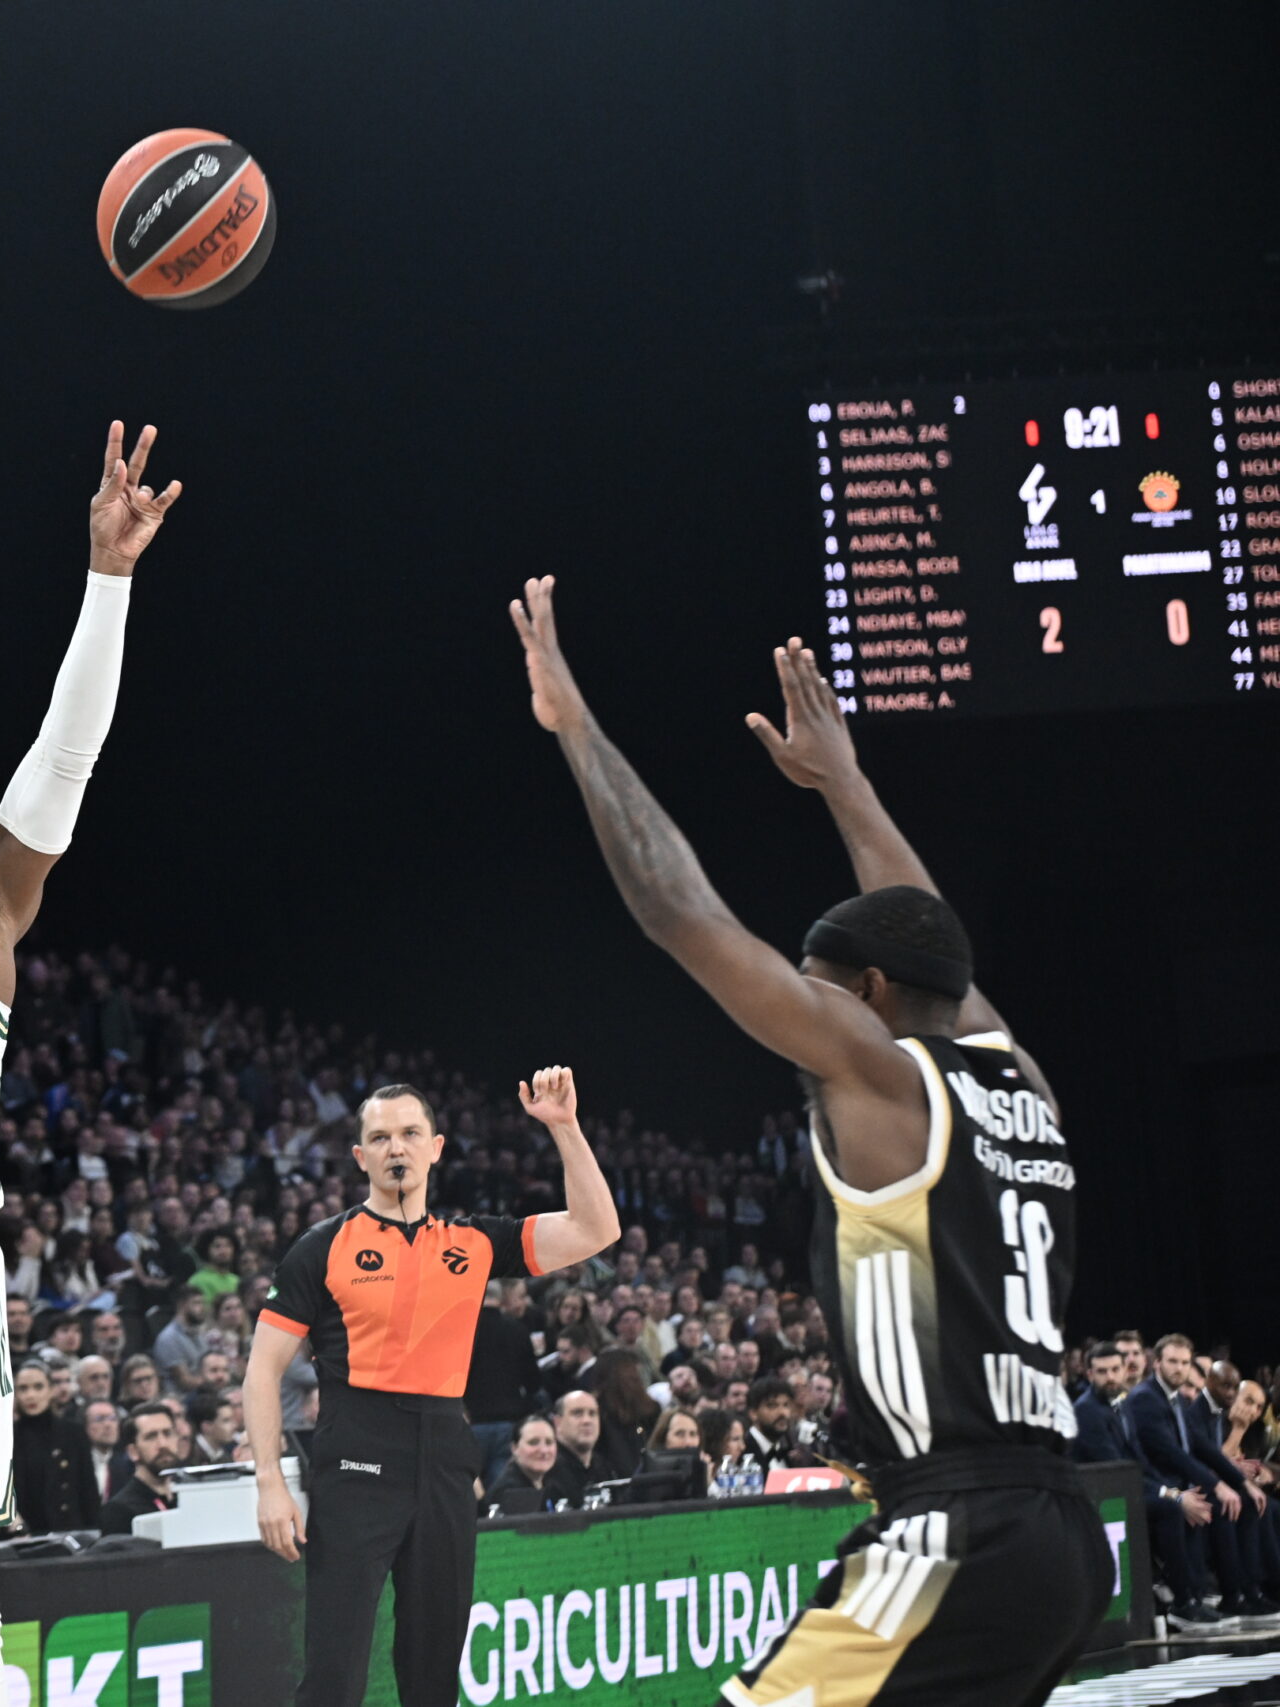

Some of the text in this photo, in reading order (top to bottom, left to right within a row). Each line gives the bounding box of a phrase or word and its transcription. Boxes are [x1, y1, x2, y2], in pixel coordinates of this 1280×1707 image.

[157, 183, 259, 288] SPALDING
[1090, 489, 1106, 514] 1
[1218, 512, 1239, 532] 17
[1220, 539, 1242, 558] 22
[1223, 565, 1244, 585] 27
[1039, 598, 1190, 654] 2 0
[1227, 618, 1250, 638] 41
[1231, 645, 1253, 665] 44
[1233, 672, 1255, 691] 77
[351, 1274, 394, 1286] motorola
[340, 1459, 382, 1475] SPALDING
[458, 1563, 799, 1706] GRICULTURAL
[6, 1639, 204, 1707] KT
